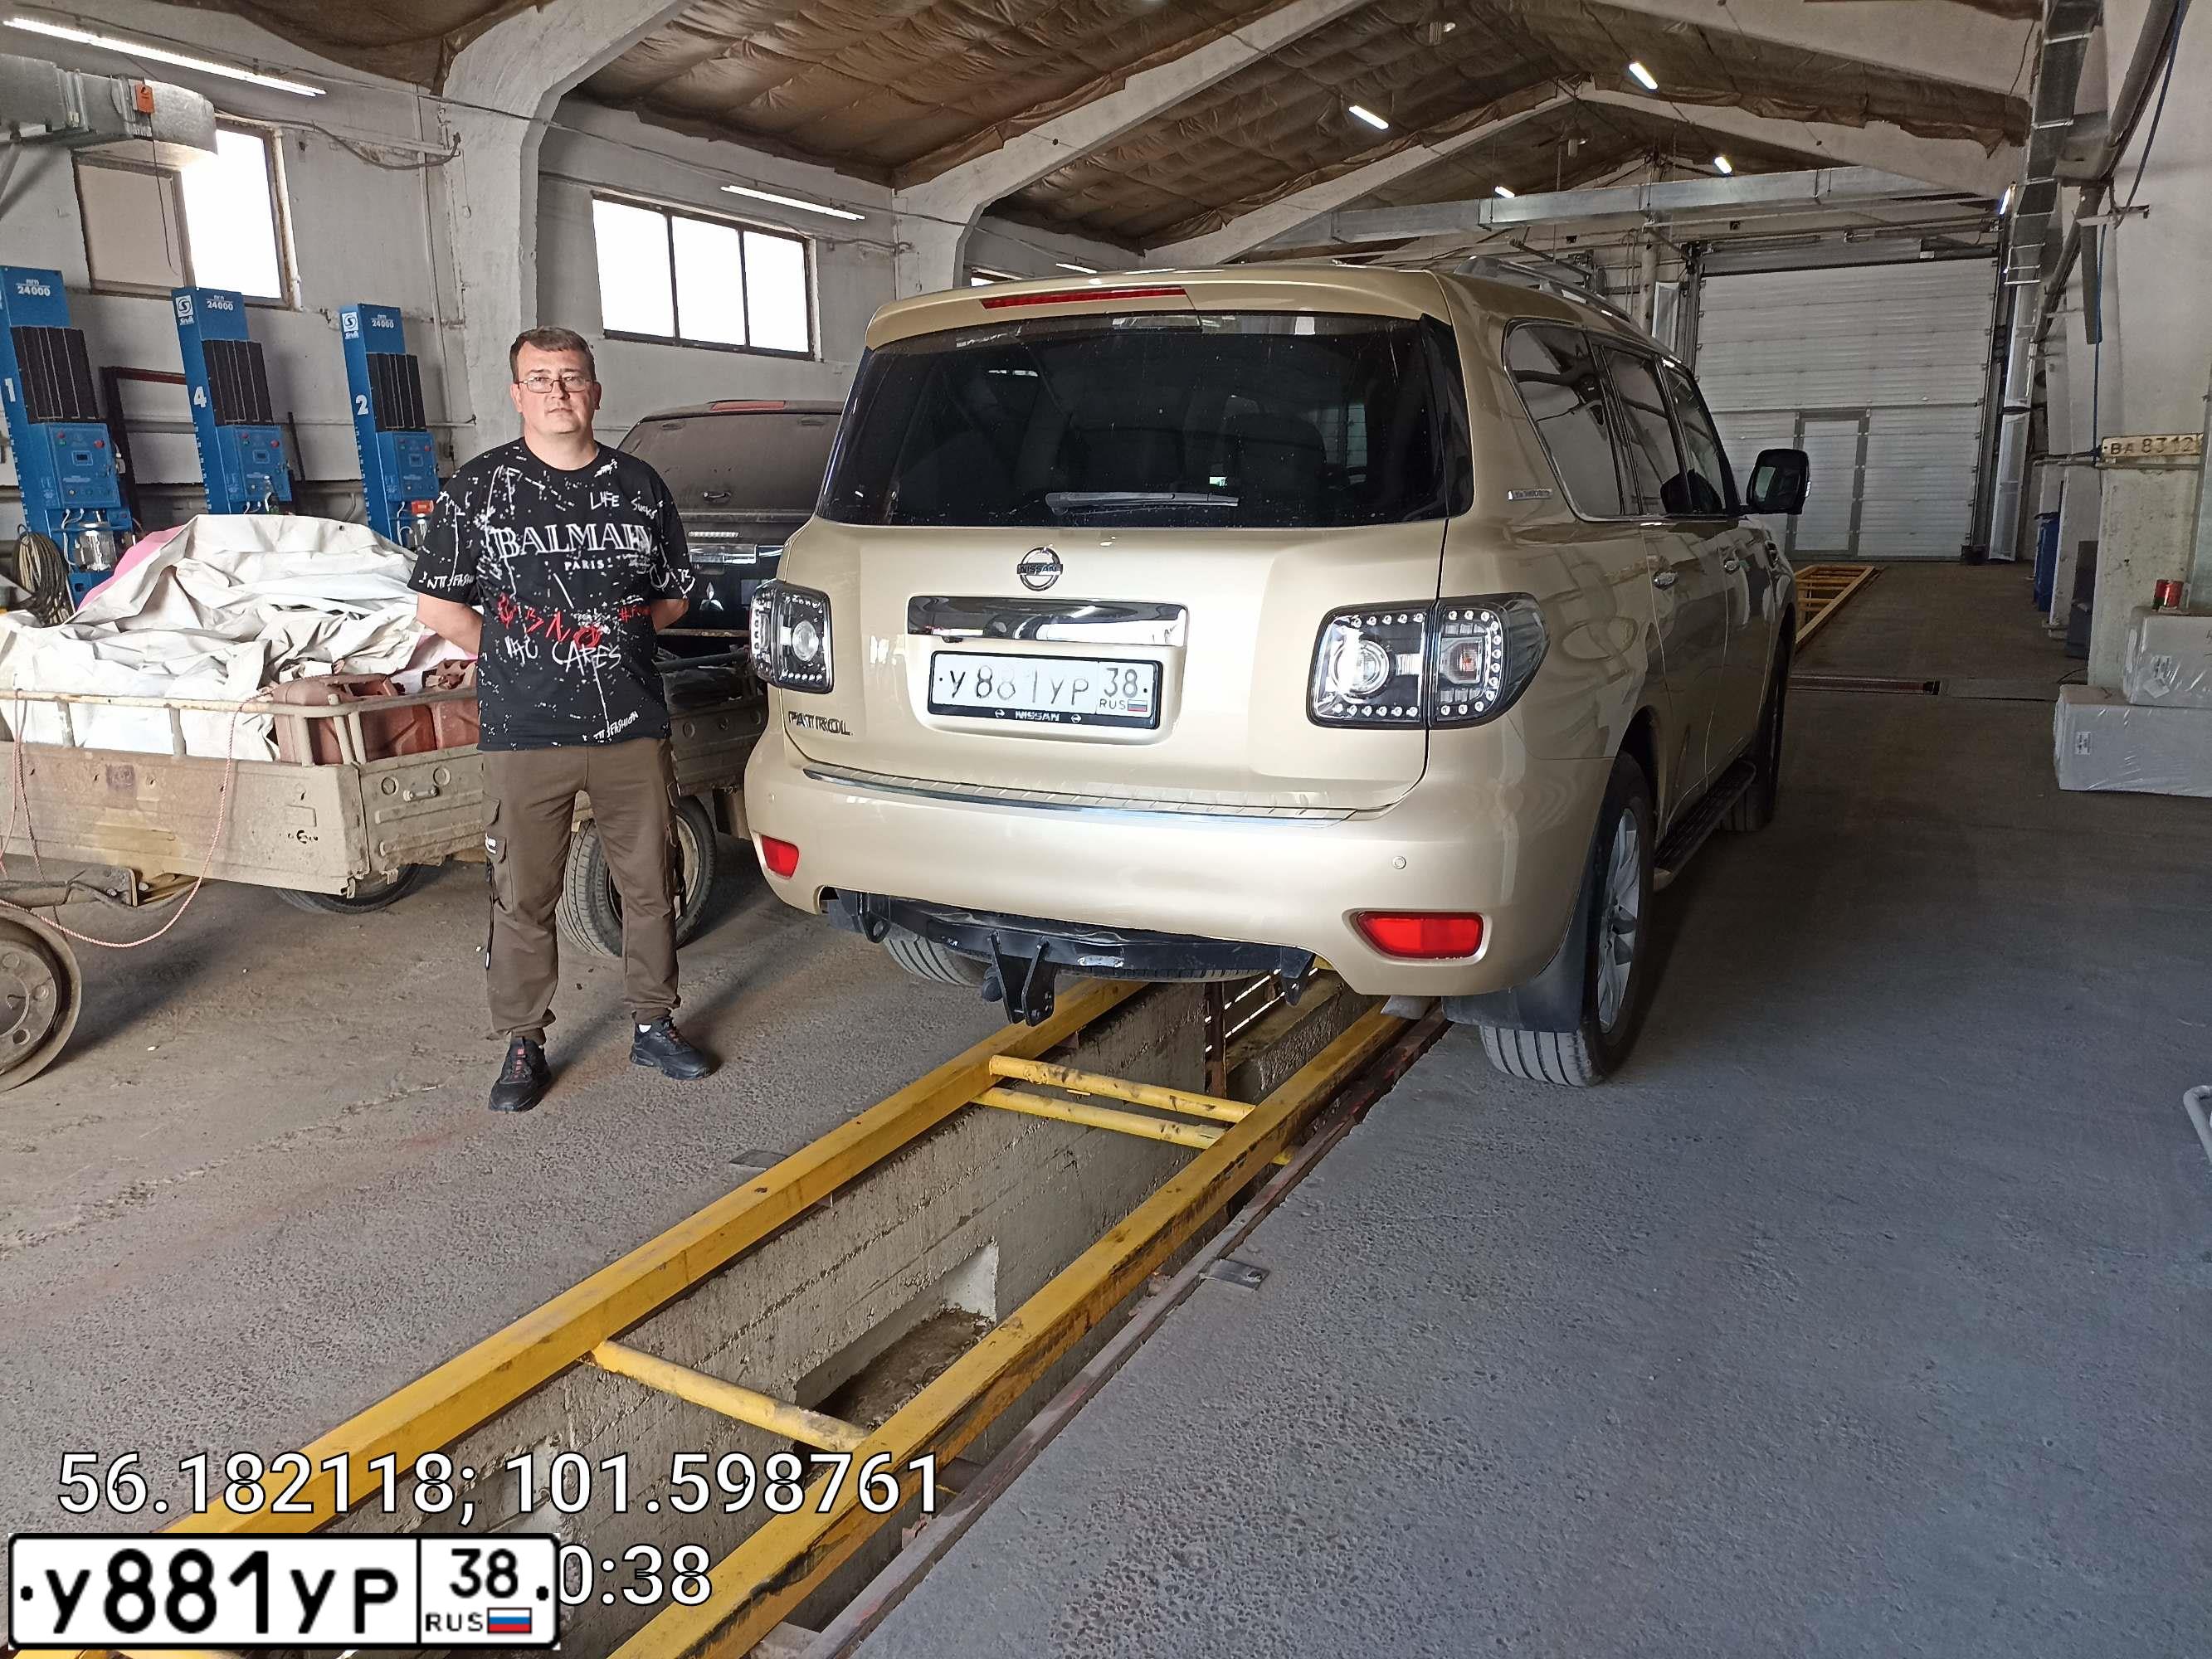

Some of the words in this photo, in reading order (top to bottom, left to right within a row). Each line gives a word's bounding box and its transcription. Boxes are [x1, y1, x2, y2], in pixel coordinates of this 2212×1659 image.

[17, 285, 51, 296] 24000
[207, 300, 234, 311] 24000
[371, 319, 394, 328] 24000
[5, 378, 16, 402] 1
[193, 386, 207, 408] 4
[355, 394, 368, 415] 2
[589, 490, 620, 510] LIFE
[1021, 565, 1058, 573] NISSAN
[1104, 667, 1138, 698] 38
[1099, 698, 1127, 710] RUS
[788, 710, 851, 736] PATROL
[1015, 711, 1060, 722] NISSAN
